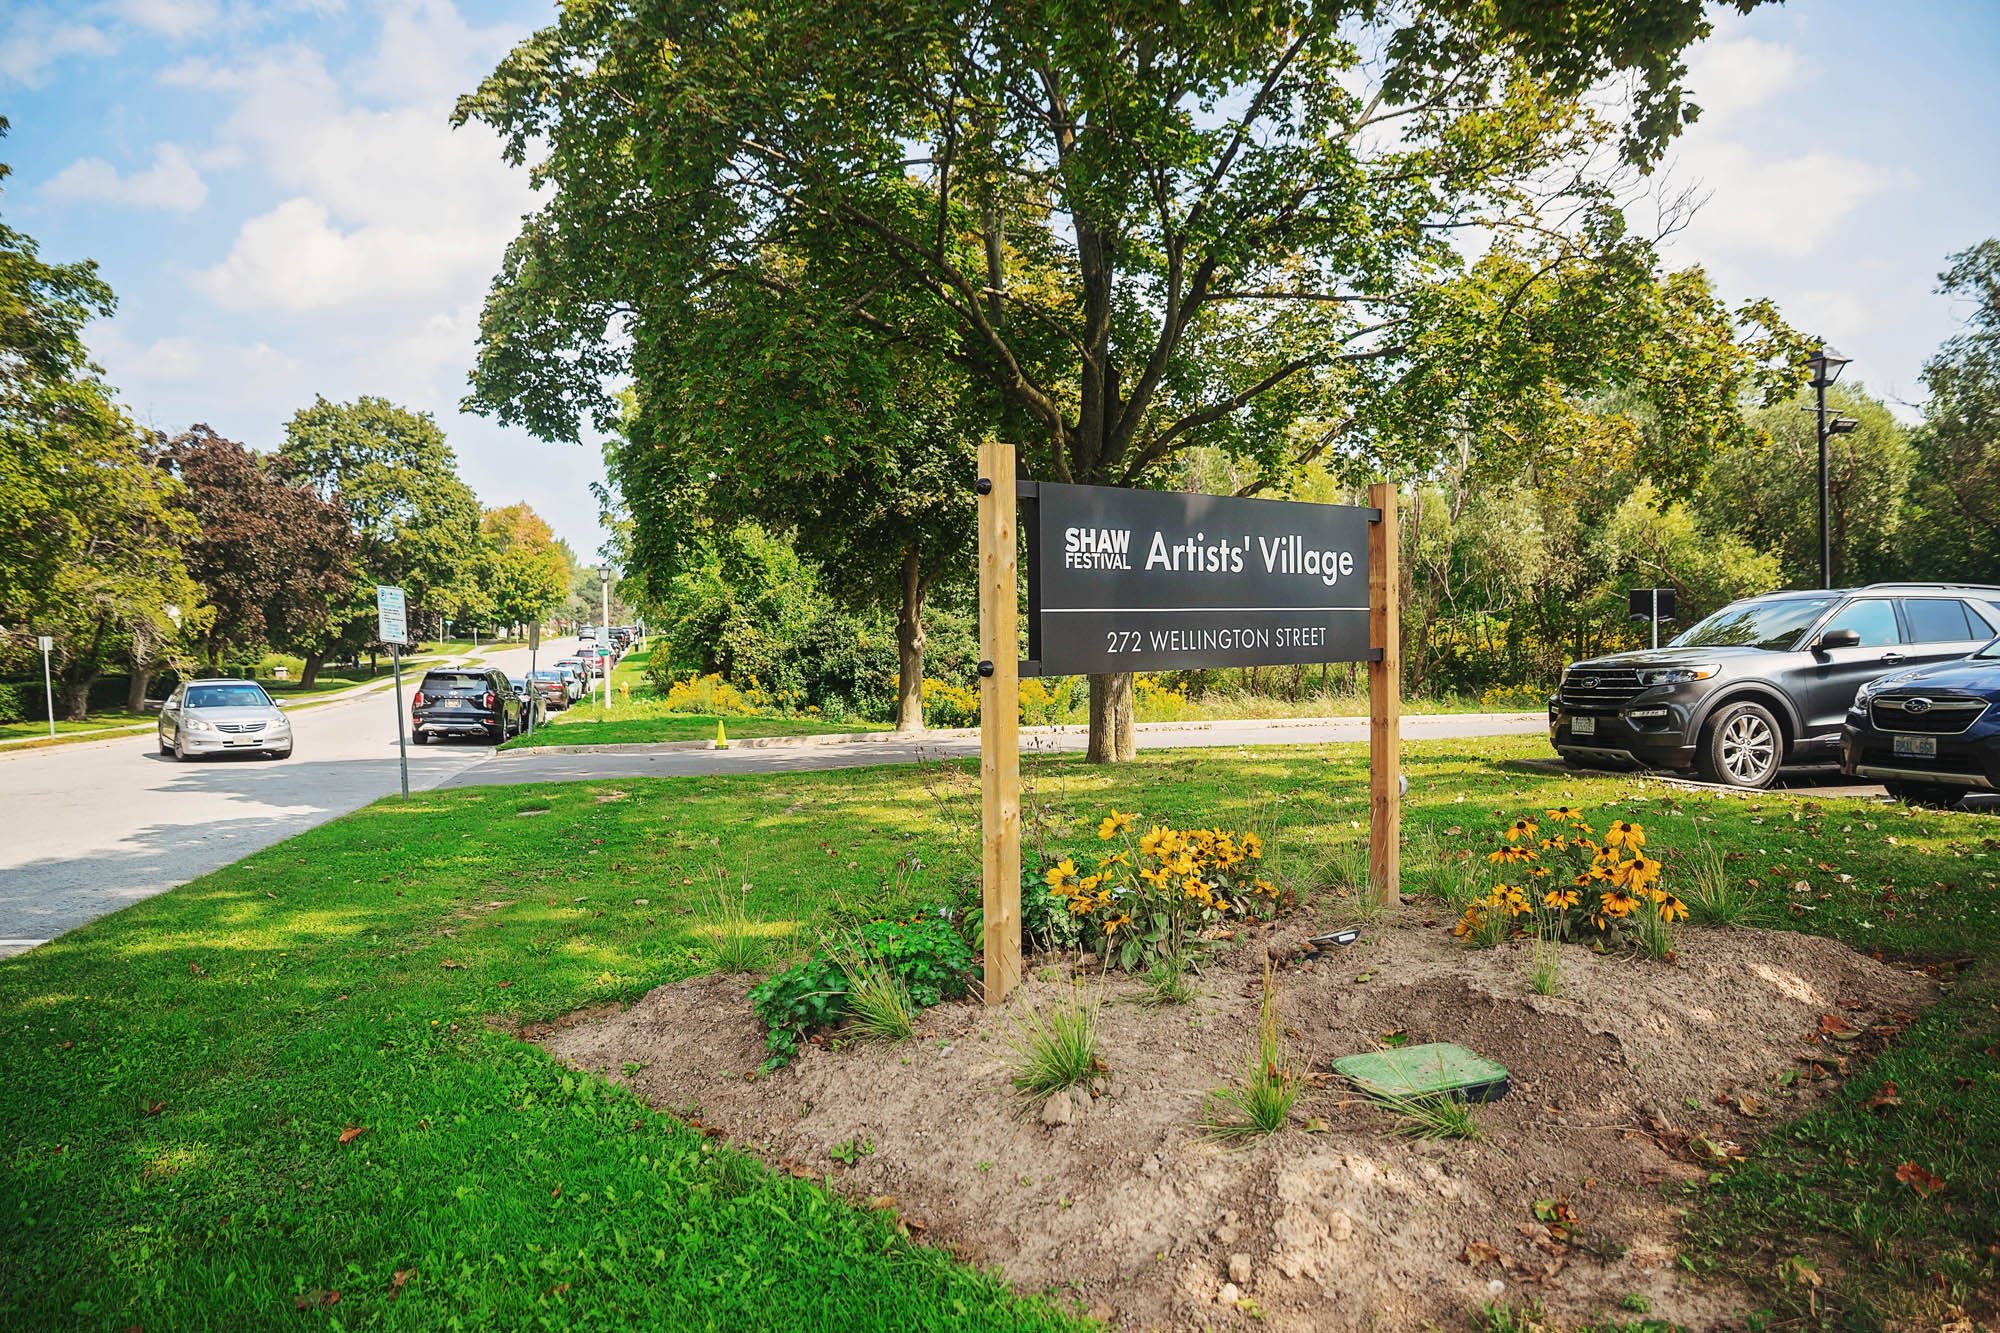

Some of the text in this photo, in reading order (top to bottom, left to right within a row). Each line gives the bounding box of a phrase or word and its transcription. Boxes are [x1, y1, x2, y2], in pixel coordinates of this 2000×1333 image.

[1065, 528, 1131, 553] SHAW
[1065, 553, 1132, 569] FESTIVAL
[1145, 532, 1353, 585] Artists' Village
[1107, 628, 1326, 652] 272 WELLINGTON STREET
